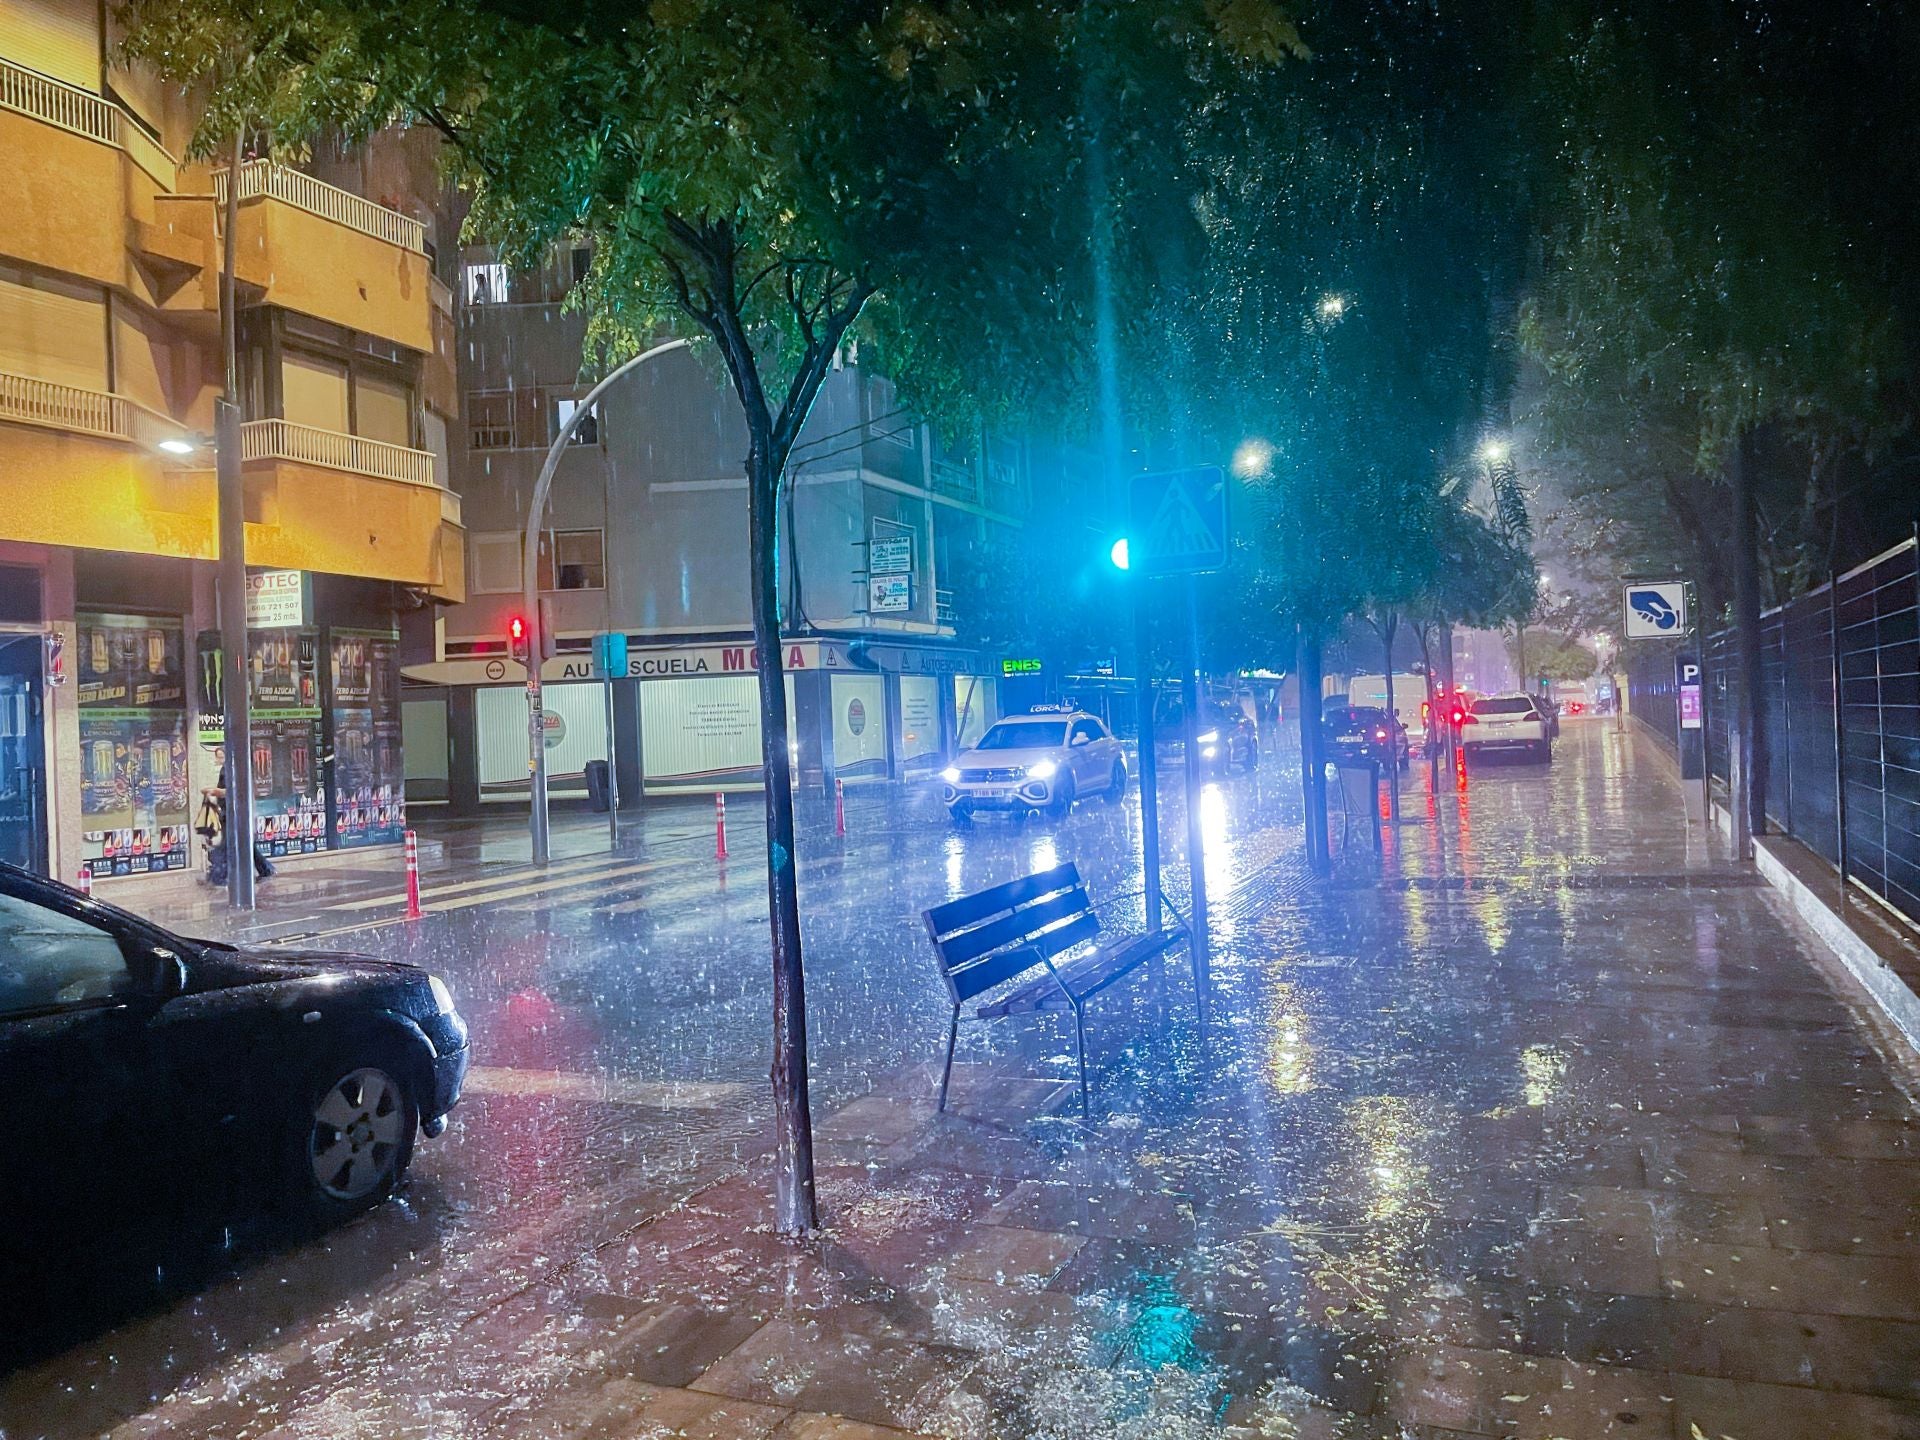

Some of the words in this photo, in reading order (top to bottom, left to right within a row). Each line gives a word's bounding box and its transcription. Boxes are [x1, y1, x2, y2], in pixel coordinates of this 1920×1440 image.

[273, 613, 282, 621] 25
[563, 658, 709, 678] AUSCUELA
[722, 646, 806, 671] MA
[1002, 659, 1042, 672] ENES
[1683, 664, 1699, 682] P
[1030, 704, 1061, 713] LORCA
